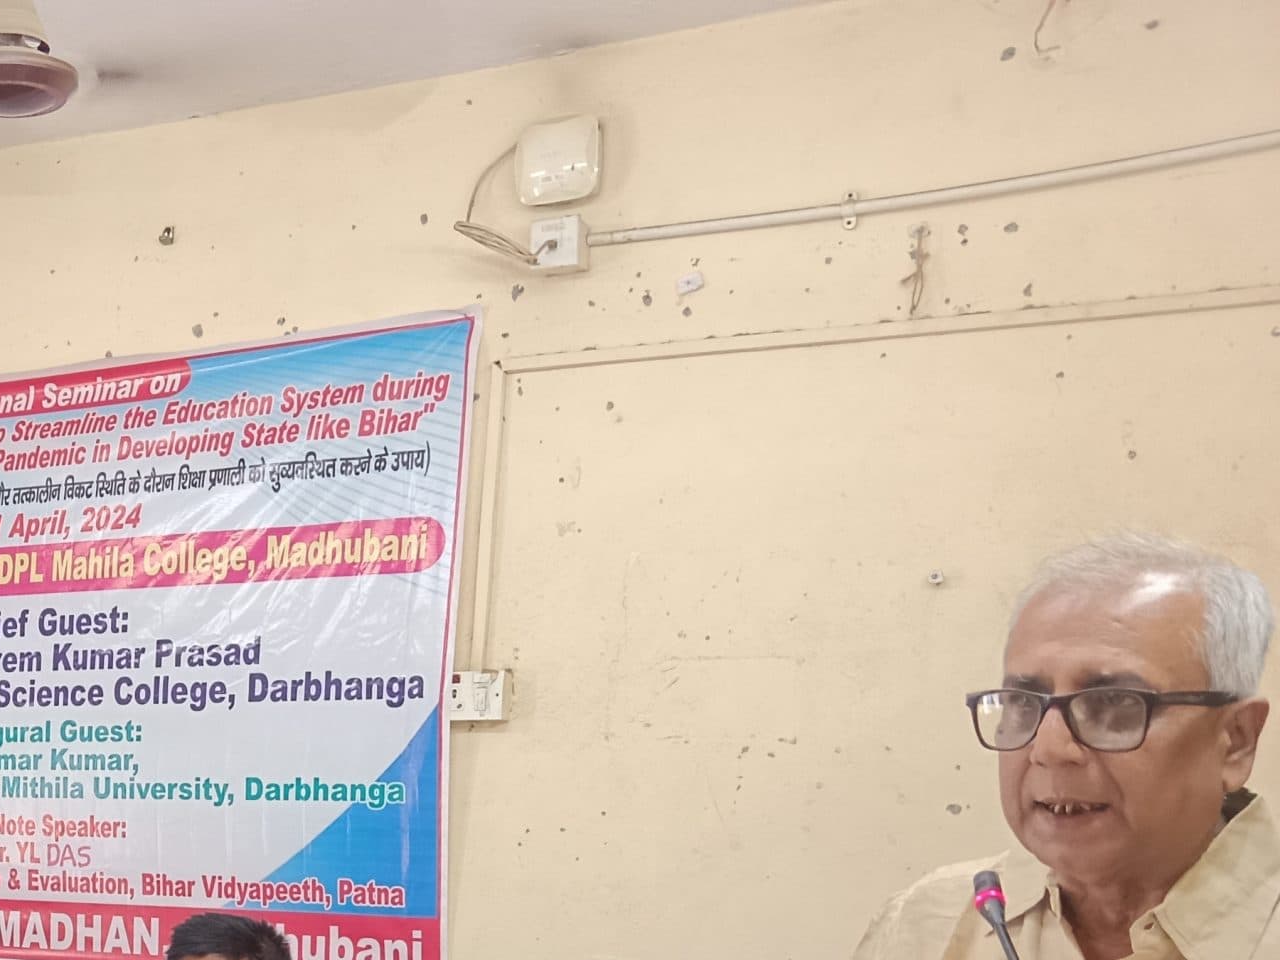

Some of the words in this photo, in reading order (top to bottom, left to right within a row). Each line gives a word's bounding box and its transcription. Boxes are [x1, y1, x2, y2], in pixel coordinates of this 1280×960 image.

[11, 411, 117, 441] Streamline
[123, 404, 156, 429] the
[163, 392, 273, 426] Education
[280, 381, 365, 418] System
[372, 370, 451, 402] during
[42, 375, 140, 408] Seminar
[149, 371, 182, 394] on
[92, 439, 111, 463] in
[116, 427, 235, 461] Developing
[240, 418, 300, 449] State
[306, 411, 351, 441] like
[358, 402, 436, 436] Bihar"
[12, 477, 62, 505] तत्कालीन
[63, 474, 94, 501] विकट
[95, 470, 128, 498] स्थिति
[128, 469, 141, 494] के
[143, 467, 176, 494] दौरान
[177, 463, 206, 491] शिक्षा
[207, 457, 247, 492] प्रणाली
[248, 456, 266, 484] को
[339, 448, 372, 476] करने
[374, 445, 389, 473] के
[391, 440, 431, 477] उपाय)
[8, 509, 71, 543] April,
[79, 503, 142, 533] 2024
[51, 544, 135, 583] Mahila
[142, 541, 256, 579] College,
[266, 525, 427, 568] Madhubani
[38, 606, 129, 637] Guest:
[52, 643, 146, 671] Kumar
[154, 635, 262, 668] Prasad
[113, 674, 236, 712] College,
[247, 670, 426, 708] Darbhanga
[60, 720, 143, 743] Guest:
[50, 749, 139, 776] Kumar,
[1, 775, 85, 799] Mithila
[93, 777, 235, 806] University,
[245, 777, 406, 808] Darbhanga
[41, 814, 128, 841] Speaker:
[16, 841, 41, 864] YL
[46, 843, 92, 867] DAS
[7, 869, 21, 890] &
[27, 870, 136, 900] Evaluation,
[141, 872, 196, 898] Bihar
[201, 875, 331, 909] Vidyapeeth,
[337, 879, 405, 906] Patna
